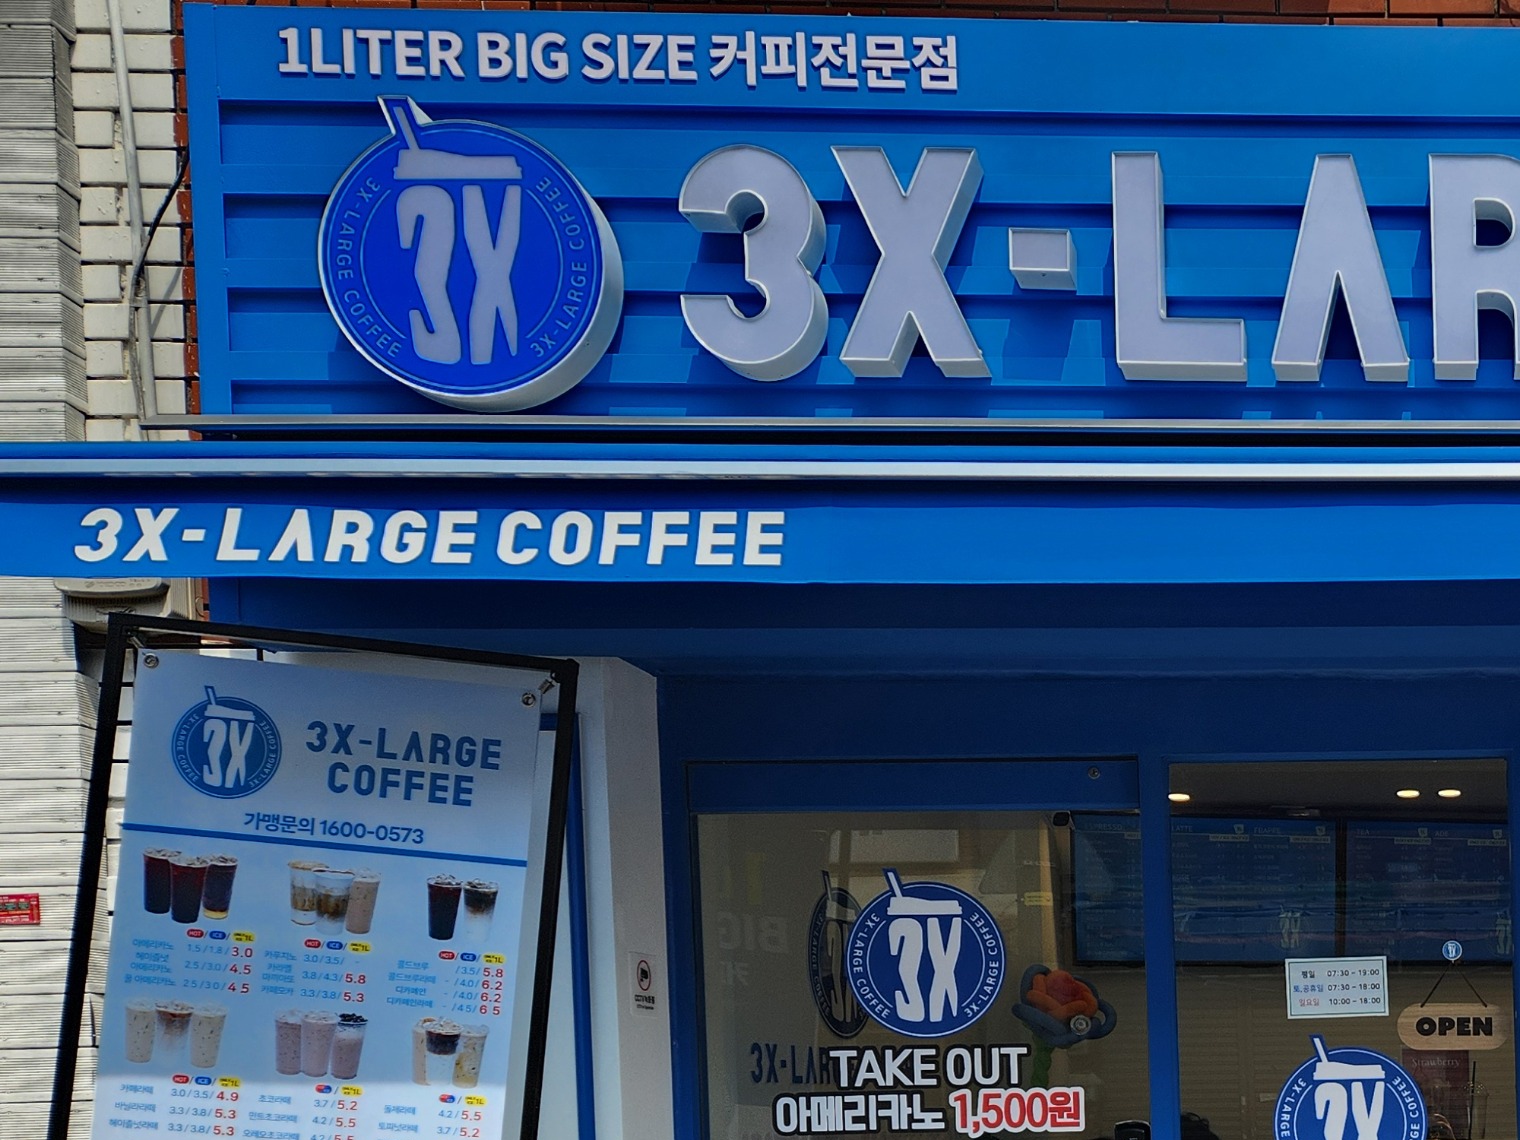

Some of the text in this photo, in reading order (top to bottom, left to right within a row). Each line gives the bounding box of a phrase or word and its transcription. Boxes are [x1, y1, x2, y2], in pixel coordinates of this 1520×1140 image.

[278, 28, 958, 92] 1LITER BIG SIZE 커피전문점
[74, 508, 785, 566] 3X-LARGE COFFEE
[304, 719, 503, 770] 3X-LARGE
[326, 761, 474, 807] COFFEE
[243, 811, 425, 844] 가맹문의 1600-0573
[231, 946, 253, 958] 3.0
[482, 967, 503, 978] 5.8
[1327, 969, 1349, 977] 07:30
[1358, 968, 1379, 976] 19:00
[343, 991, 364, 1002] 5.3
[480, 992, 501, 1003] 6.2
[856, 976, 891, 1019] COFFEE
[1416, 1017, 1493, 1036] OPEN
[829, 1046, 1029, 1088] TAKE OUT
[1412, 1058, 1460, 1067] Strawberry
[215, 1090, 239, 1102] 4.9
[1392, 1076, 1420, 1118] COFFEE
[336, 1099, 357, 1111] 5.2
[214, 1108, 236, 1119] 5.3
[774, 1090, 1082, 1134] 아메리카노 1,500원
[335, 1116, 356, 1128] 5.5
[212, 1125, 234, 1136] 5.3
[459, 1127, 479, 1138] 5.2
